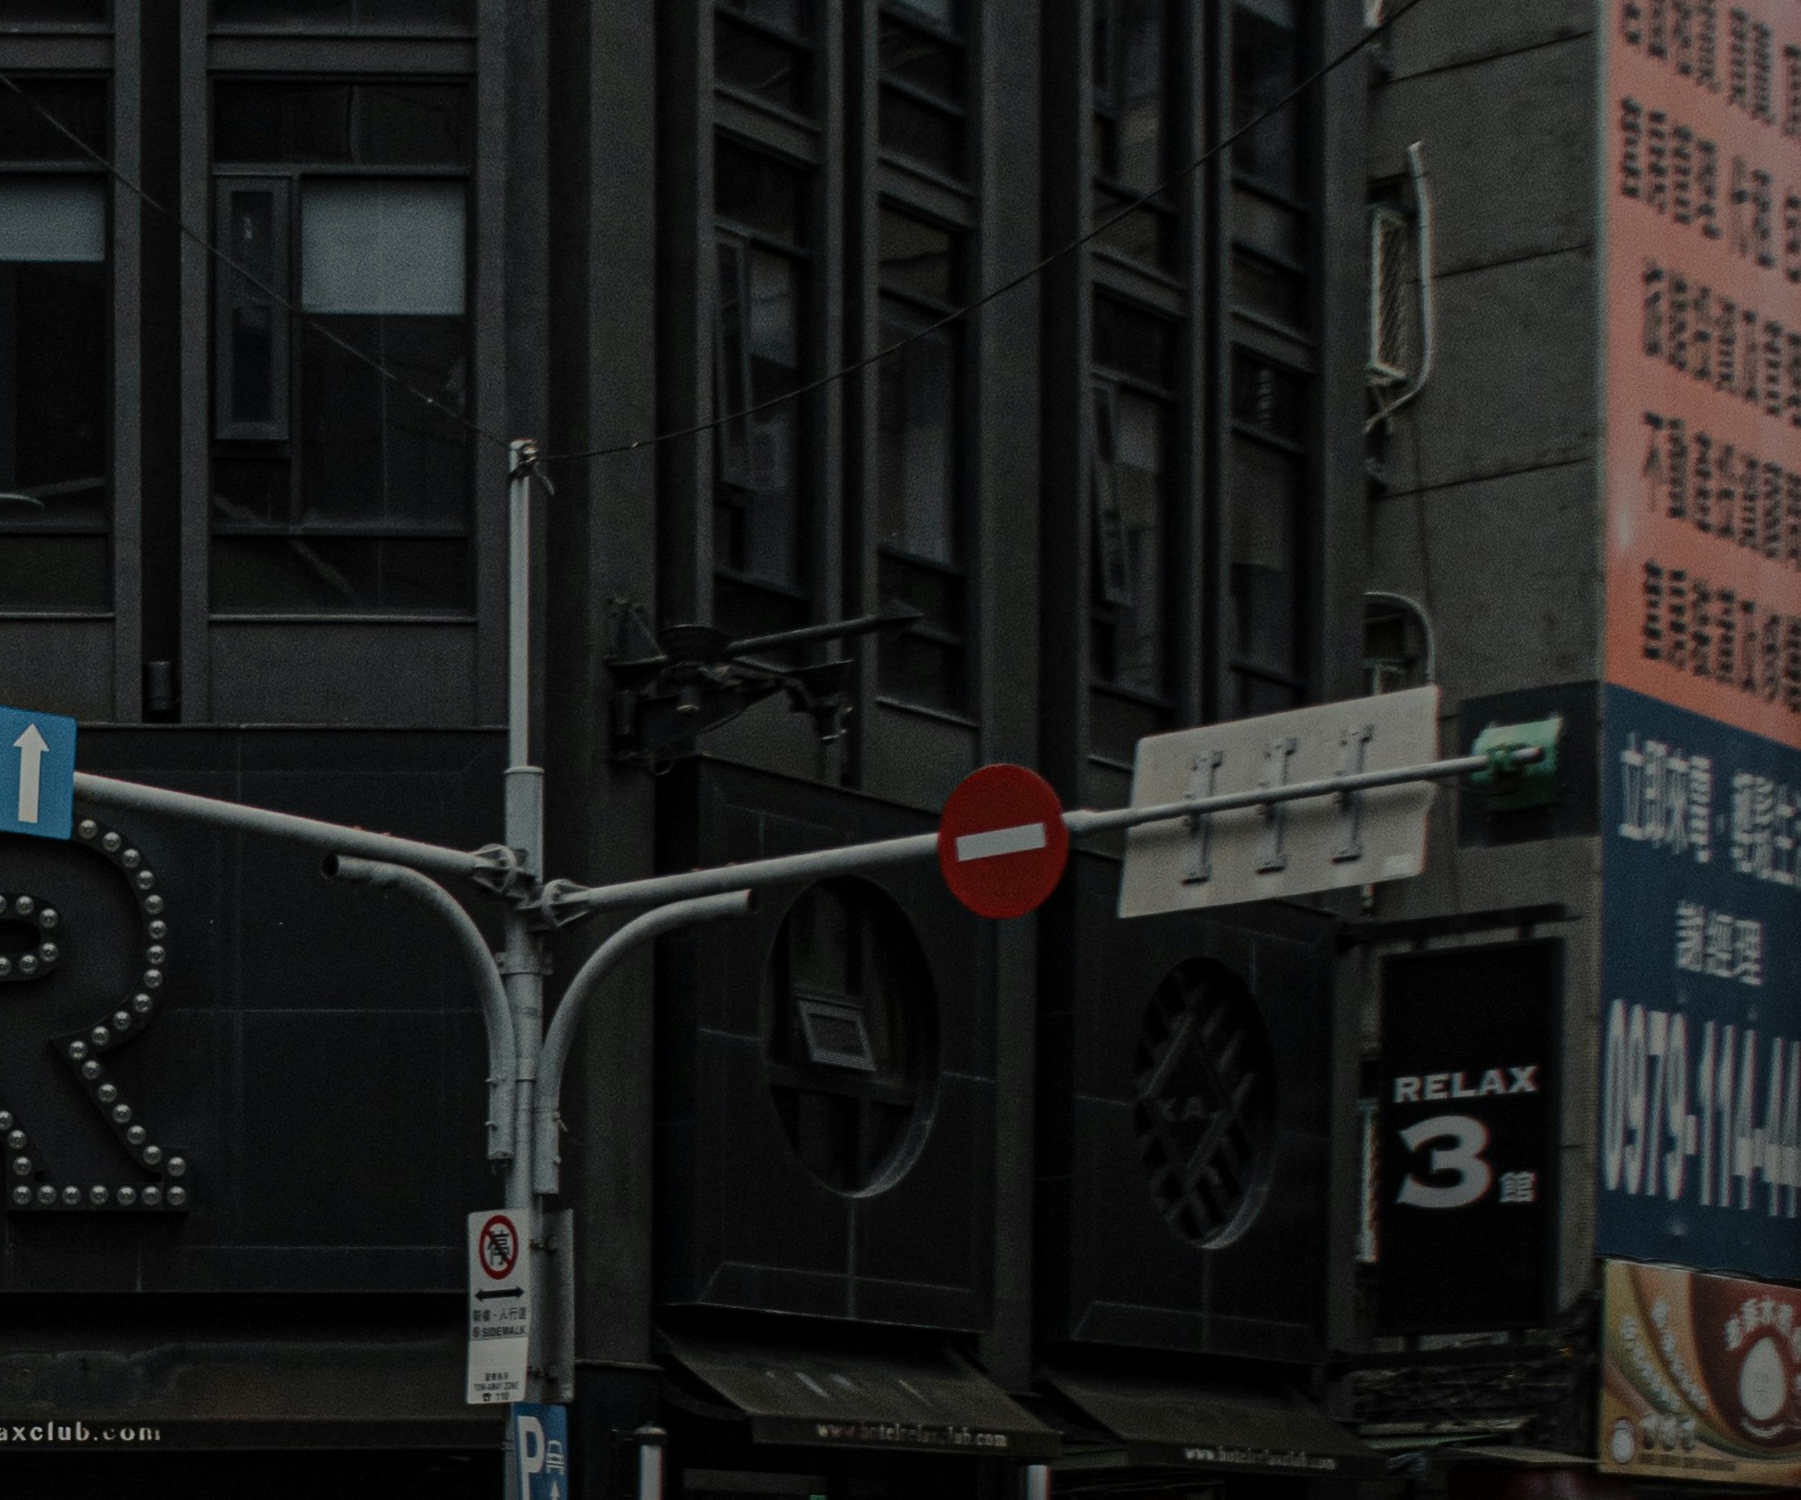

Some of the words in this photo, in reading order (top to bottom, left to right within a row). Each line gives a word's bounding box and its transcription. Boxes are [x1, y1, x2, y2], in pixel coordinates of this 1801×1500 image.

[1392, 1063, 1540, 1103] RELAX
[1395, 1113, 1537, 1210] 3館
[482, 1325, 527, 1337] SIDEWALK
